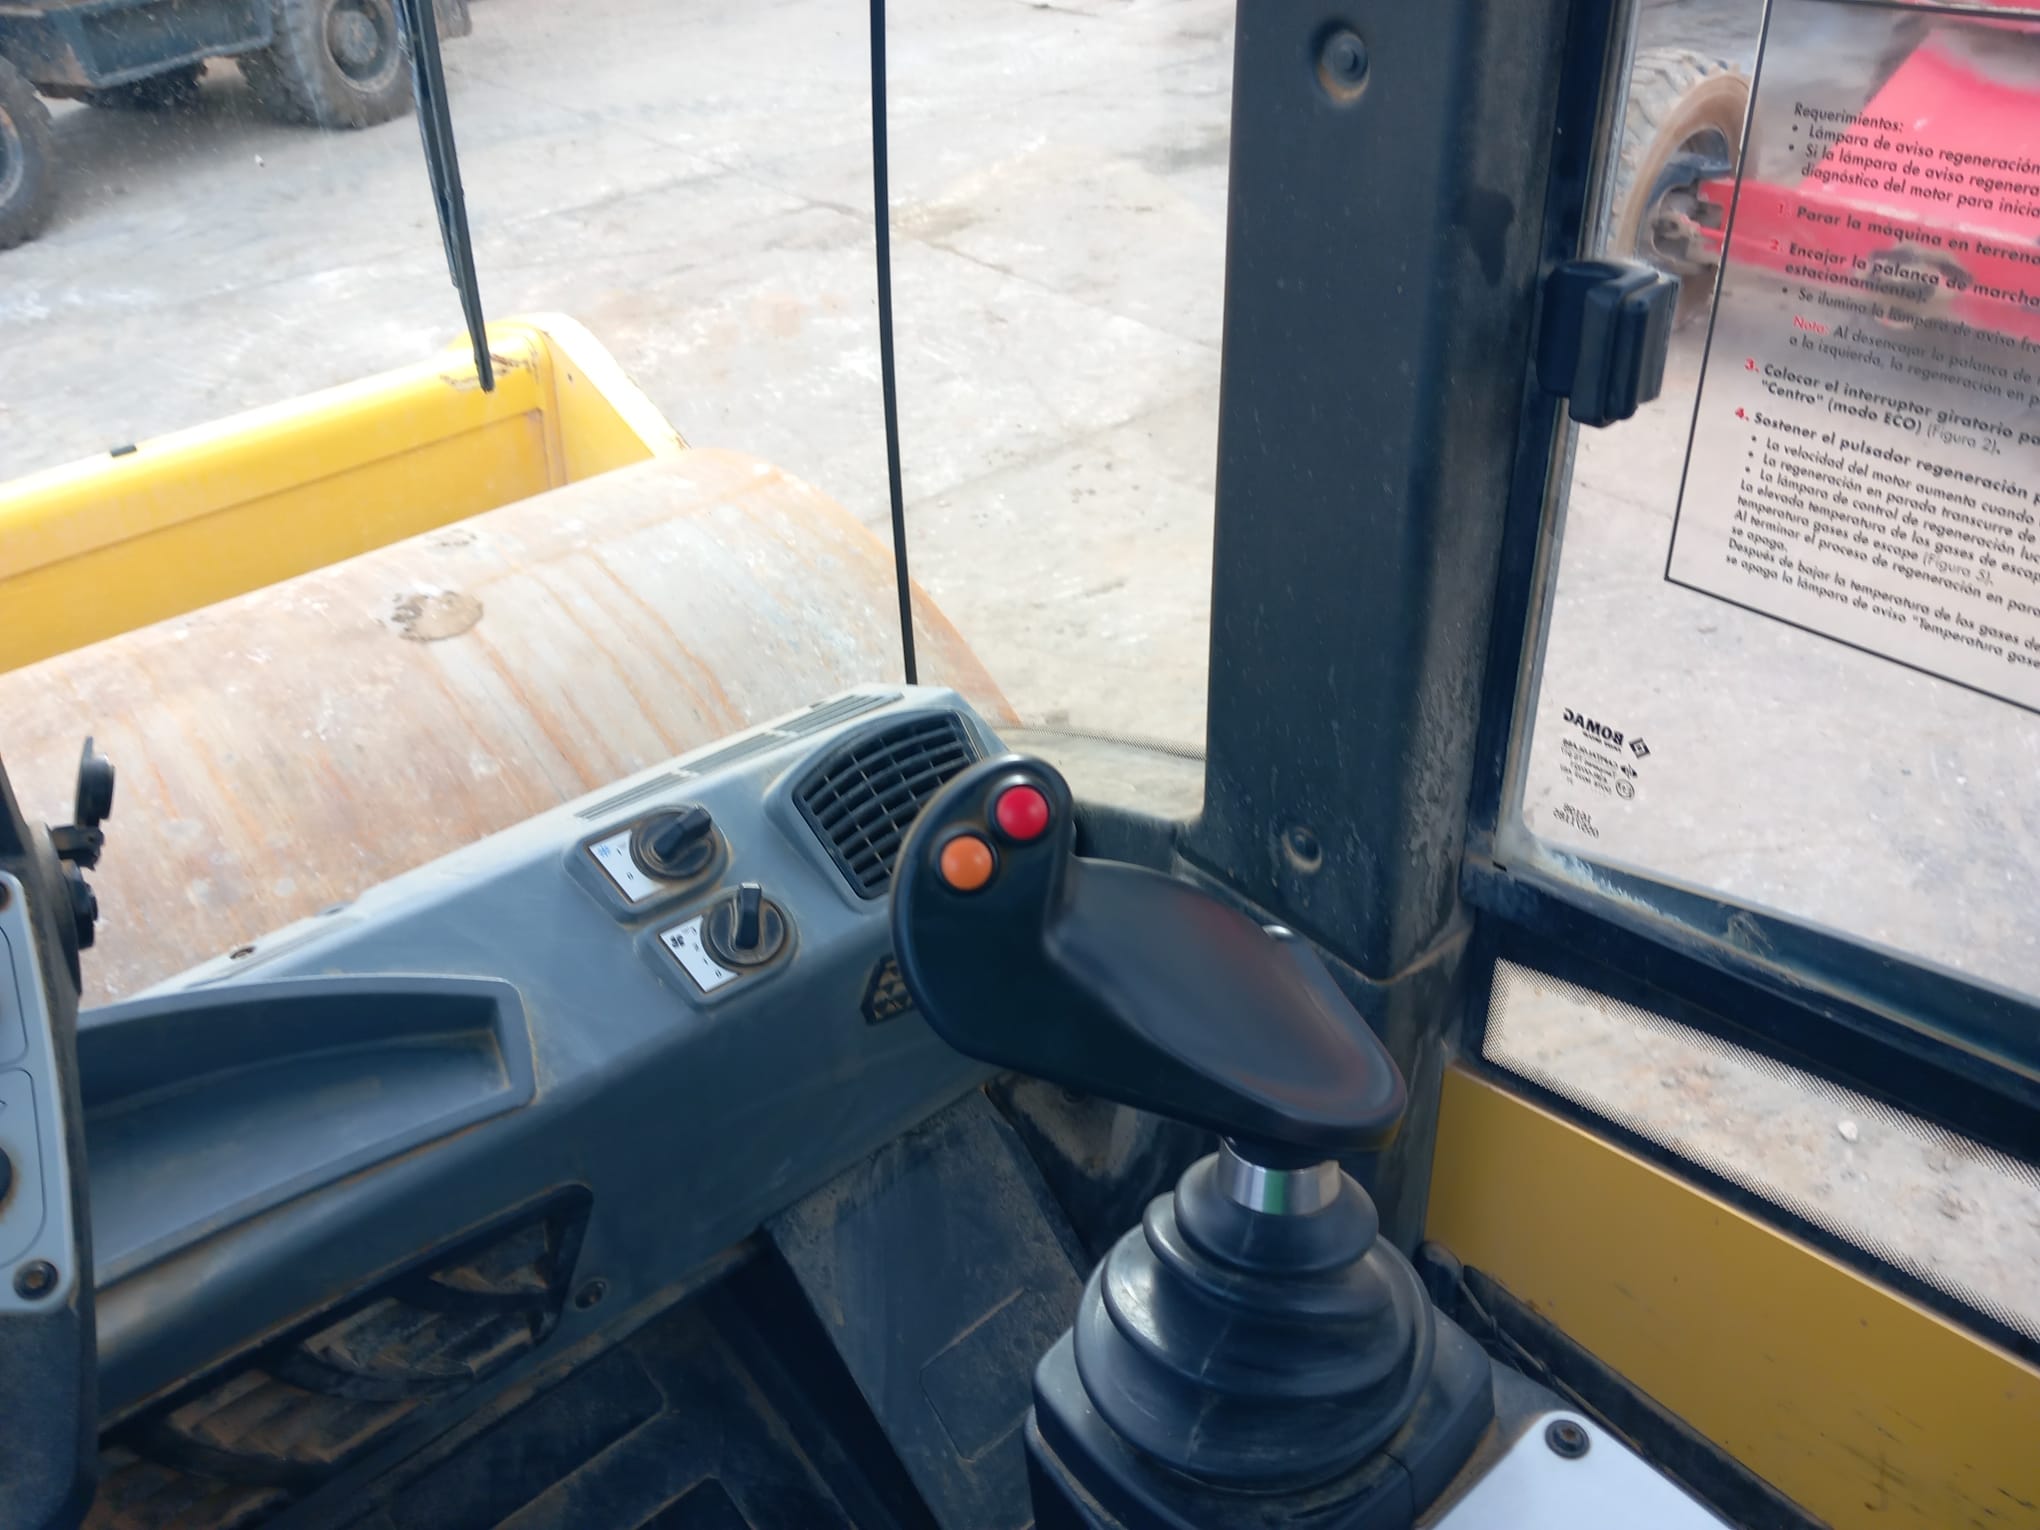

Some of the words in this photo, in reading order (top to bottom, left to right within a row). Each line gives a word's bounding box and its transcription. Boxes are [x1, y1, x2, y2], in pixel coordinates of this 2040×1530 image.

[1794, 102, 1904, 132] Requerimientos:
[1809, 125, 1869, 147] Lámpara
[1873, 135, 1891, 150] de
[1896, 141, 1934, 158] aviso
[1939, 149, 2040, 176] regeneración
[1801, 162, 1879, 189] diagnóstico
[1884, 177, 1906, 194] del
[1910, 185, 1953, 201] motor
[1957, 194, 1993, 210] para
[1805, 144, 1817, 158] Si
[1822, 148, 1834, 161] la
[1839, 150, 1897, 172] lámpara
[1903, 160, 1920, 176] de
[1925, 167, 1964, 184] aviso
[1796, 205, 1840, 225] Parar
[1846, 214, 1861, 229] la
[1868, 221, 1942, 245] máquina
[1948, 238, 1969, 252] en
[1789, 242, 1847, 266] Encajar
[1852, 254, 1867, 270] la
[1872, 262, 1940, 285] palanca
[1946, 275, 1968, 291] de
[1793, 315, 1829, 336] Nota:
[1833, 325, 1848, 340] Al
[1852, 329, 1928, 357] desencajar
[1931, 347, 1944, 362] la
[1948, 355, 2008, 377] palanca
[2013, 368, 2032, 383] de
[1798, 287, 1814, 301] Se
[1818, 291, 1867, 314] ilumina
[1871, 303, 1884, 319] la
[1953, 321, 1971, 336] de
[1976, 331, 2015, 348] aviso
[1744, 357, 1760, 373] 3.
[1764, 363, 1820, 388] Colocar
[1824, 380, 1839, 393] el
[1844, 383, 1932, 416] interruptor
[1937, 409, 2013, 438] giratorio
[1802, 335, 1814, 350] la
[1890, 356, 1903, 371] la
[1907, 364, 2001, 395] regeneración
[2006, 389, 2025, 403] en
[1762, 379, 1824, 405] "Centro"
[1827, 399, 1878, 421] (modo
[1883, 412, 1922, 436] ECO)
[1927, 423, 1976, 448] (Figura
[1735, 407, 1750, 421] 4.
[1754, 412, 1817, 439] Sostener
[1821, 432, 1836, 446] el
[1840, 439, 1912, 466] pulsador
[1916, 459, 2028, 500] regeneración
[1766, 437, 1780, 450] La
[1784, 445, 1845, 470] velocidad
[1848, 460, 1869, 477] del
[1872, 470, 1912, 489] motor
[1916, 483, 1976, 508] aumenta
[1981, 502, 2034, 525] cuando
[1731, 526, 1743, 536] se
[1740, 479, 1753, 492] La
[1757, 486, 1804, 509] elevada
[1808, 501, 1886, 534] temperatura
[1891, 526, 1907, 540] de
[1912, 530, 1930, 548] los
[1934, 541, 1974, 561] gases
[1979, 551, 1997, 567] de
[1760, 469, 1773, 482] La
[1777, 473, 1828, 499] lámpara
[1832, 491, 1848, 505] de
[1852, 500, 1898, 520] control
[1902, 511, 1919, 526] de
[1923, 521, 2015, 555] regeneración
[1763, 453, 1776, 467] La
[1780, 460, 1862, 493] regeneración
[1866, 487, 1882, 499] en
[1886, 492, 1936, 514] parada
[1941, 506, 2013, 537] transcurre
[2018, 528, 2036, 543] de
[1734, 509, 1747, 523] Al
[1750, 515, 1801, 539] terminar
[1804, 530, 1816, 544] el
[1818, 537, 1867, 561] proceso
[1872, 554, 1888, 568] de
[1892, 562, 1981, 598] regeneración
[1985, 592, 2003, 606] en
[1737, 496, 1809, 526] temperatura
[1813, 521, 1848, 539] gases
[1853, 531, 1869, 544] de
[1873, 539, 1918, 562] escape
[1923, 551, 1971, 577] (Figura
[1726, 555, 1738, 566] se
[1741, 560, 1778, 580] apaga
[1782, 571, 1793, 585] la
[1797, 575, 1848, 603] lámpara
[1852, 595, 1868, 610] de
[1872, 606, 1907, 624] aviso
[1912, 615, 2003, 656] "Temperatura
[1728, 537, 1775, 562] Después
[1779, 555, 1794, 569] de
[1797, 560, 1830, 581] bajar
[1834, 572, 1846, 586] la
[1850, 580, 1930, 614] temperatura
[1934, 606, 1951, 621] de
[1955, 611, 1975, 630] los
[1978, 624, 2019, 645] gases
